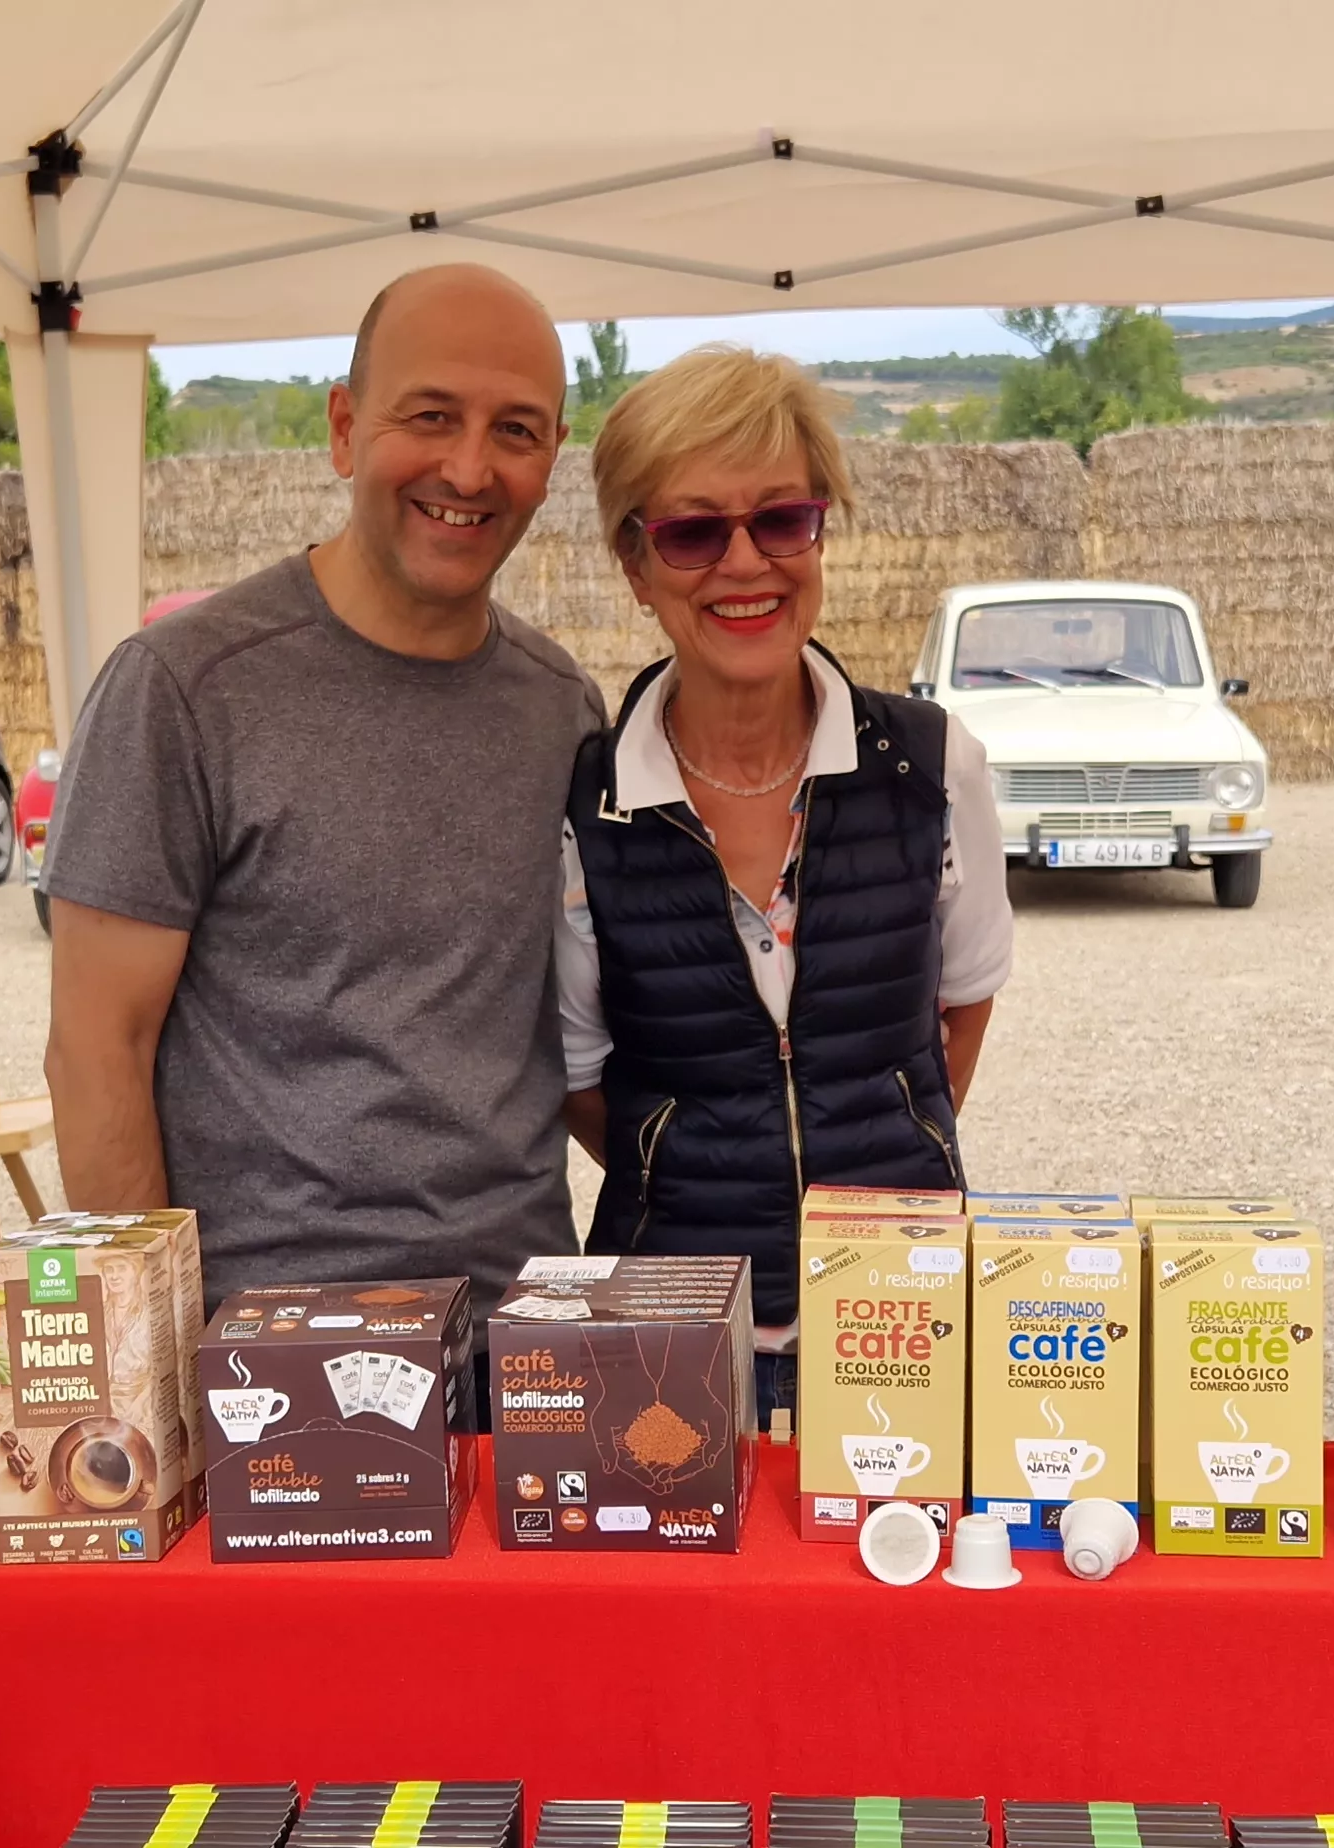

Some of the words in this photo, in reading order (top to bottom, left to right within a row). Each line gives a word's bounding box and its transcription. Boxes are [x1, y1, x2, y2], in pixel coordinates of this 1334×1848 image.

[1062, 845, 1086, 863] LE
[1095, 844, 1142, 863] 4914
[1152, 844, 1163, 862] B
[1174, 1248, 1203, 1266] cápsulas
[806, 1252, 862, 1286] COMPOSTABLES
[979, 1253, 1034, 1288] COMPOSTABLES
[1159, 1254, 1215, 1290] COMPOSTABLES
[40, 1279, 66, 1288] OXFAM
[36, 1289, 71, 1298] Intermón
[836, 1299, 932, 1322] FORTE
[1009, 1301, 1105, 1317] DESCAFEINADO
[1189, 1301, 1287, 1318] FRAGANTE
[22, 1309, 89, 1337] Tierra
[837, 1320, 887, 1330] CÁPSULAS
[1186, 1316, 1225, 1324] 100%
[937, 1326, 945, 1336] 9
[1112, 1328, 1120, 1336] 5
[835, 1323, 932, 1361] café
[1009, 1325, 1105, 1361] café
[1190, 1326, 1289, 1364] café
[21, 1339, 94, 1368] Madre
[500, 1348, 555, 1372] café
[835, 1361, 931, 1376] ECOLÓGICO
[1008, 1363, 1105, 1379] ECOLÓGICO
[1190, 1365, 1288, 1381] ECOLÓGICO
[30, 1377, 51, 1387] CAFÉ
[53, 1377, 88, 1387] MOLIDO
[501, 1372, 587, 1392] soluble
[835, 1376, 892, 1386] COMERCIO
[896, 1378, 930, 1388] JUSTO
[1008, 1378, 1067, 1389] COMERCIO
[1069, 1379, 1105, 1390] JUSTO
[1190, 1381, 1250, 1391] COMERCIO
[1253, 1383, 1288, 1392] JUSTO
[21, 1385, 99, 1404] NATURAL
[503, 1391, 584, 1408] liofilizado
[28, 1407, 67, 1415] COMERCIO
[220, 1400, 261, 1411] ALTER
[221, 1411, 260, 1421] NATIVA
[503, 1424, 553, 1432] COMERCIO
[556, 1424, 585, 1432] JUSTO
[853, 1448, 897, 1460] ALTER
[1027, 1451, 1072, 1464] ALTER
[1210, 1454, 1255, 1465] ALTER
[248, 1455, 294, 1473] café
[853, 1459, 896, 1470] NATIVA
[1027, 1462, 1071, 1474] NATIVA
[1210, 1466, 1255, 1477] NATIVA
[249, 1473, 322, 1489] soluble
[356, 1474, 367, 1483] 25
[369, 1473, 395, 1483] sobres
[396, 1473, 402, 1481] 2
[250, 1488, 320, 1503] liofilizado
[92, 1519, 108, 1527] MÁS
[110, 1519, 138, 1527] JUSTO?
[659, 1509, 717, 1524] ALTER
[659, 1523, 716, 1537] NATIVA
[227, 1528, 432, 1548] www.alternativa3.com
